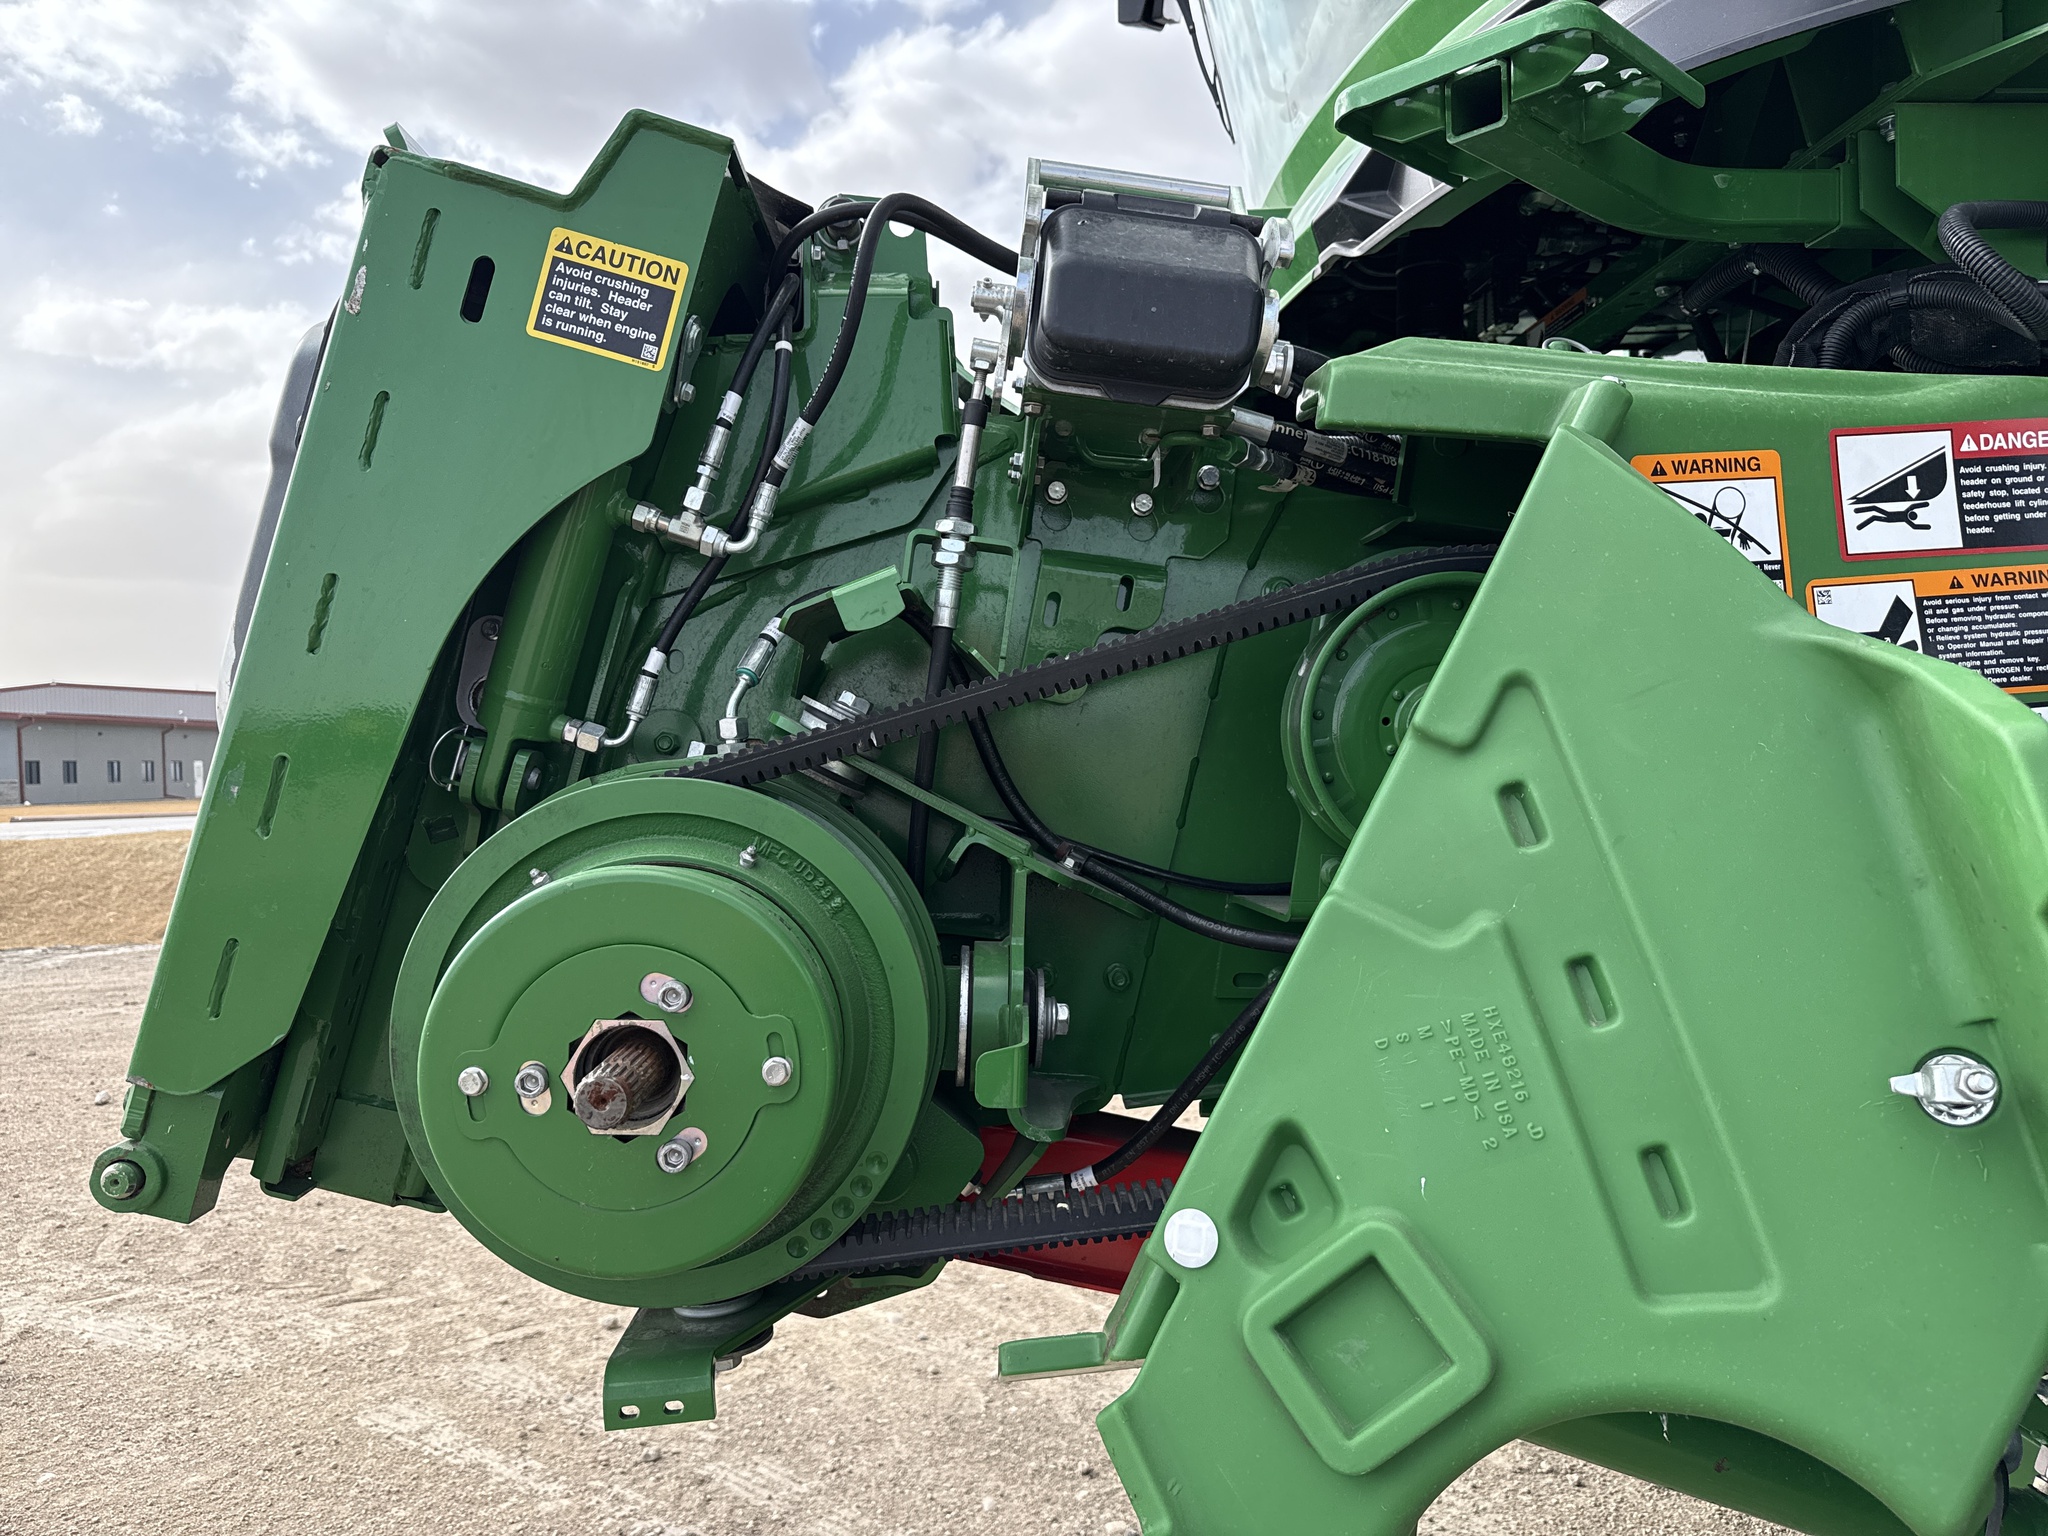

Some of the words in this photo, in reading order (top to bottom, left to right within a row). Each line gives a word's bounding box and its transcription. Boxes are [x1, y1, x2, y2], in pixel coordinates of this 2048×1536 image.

[575, 240, 681, 285] CAUTION
[555, 262, 592, 280] Avoid
[595, 274, 649, 299] crushing
[552, 275, 600, 298] injuries.
[608, 290, 653, 312] Header
[548, 290, 570, 303] can
[574, 296, 593, 310] tilt.
[600, 303, 628, 322] Stay
[541, 314, 552, 327] is
[555, 320, 607, 343] running.
[545, 303, 576, 319] clear
[579, 313, 611, 330] when
[614, 322, 657, 342] engine
[1979, 430, 2048, 451] DANGE
[1671, 456, 1761, 475] WARNING
[1959, 465, 1981, 474] Avoid
[1985, 463, 2020, 473] crushing
[2023, 462, 2047, 472] injury.
[1960, 477, 1987, 486] header
[2005, 475, 2033, 485] ground
[1962, 490, 1985, 499] safety
[1989, 489, 2009, 497] stop,
[2012, 486, 2040, 495] located
[1963, 501, 2011, 510] feederhouse
[2015, 499, 2025, 507] lift
[2029, 499, 2048, 508] cylin
[1965, 514, 1990, 522] before
[1993, 512, 2021, 522] getting
[2024, 511, 2047, 519] under
[1966, 526, 1995, 534] header.
[1971, 570, 2048, 588] WARNIN
[1972, 596, 1992, 604] injury
[1951, 607, 1964, 615] gas
[1990, 603, 2021, 611] pressure.
[1984, 612, 2015, 621] hydraulic
[1971, 622, 2018, 630] accumulators:
[1936, 634, 1960, 642] Relieve
[1990, 630, 2021, 638] hydraulic
[1947, 642, 1976, 650] Operator
[1979, 640, 2003, 648] Manual
[2022, 637, 2044, 645] Repair
[1938, 652, 1962, 660] system
[1984, 667, 2020, 675] NITROGEN
[1185, 911, 1246, 936] ALFAGOMMA
[1417, 1025, 1434, 1039] M
[1374, 1037, 1390, 1050] D
[1483, 1005, 1530, 1102] HXE48216
[1460, 1012, 1491, 1062] MADE
[1482, 1071, 1502, 1092] IN
[1494, 1099, 1518, 1139] USA
